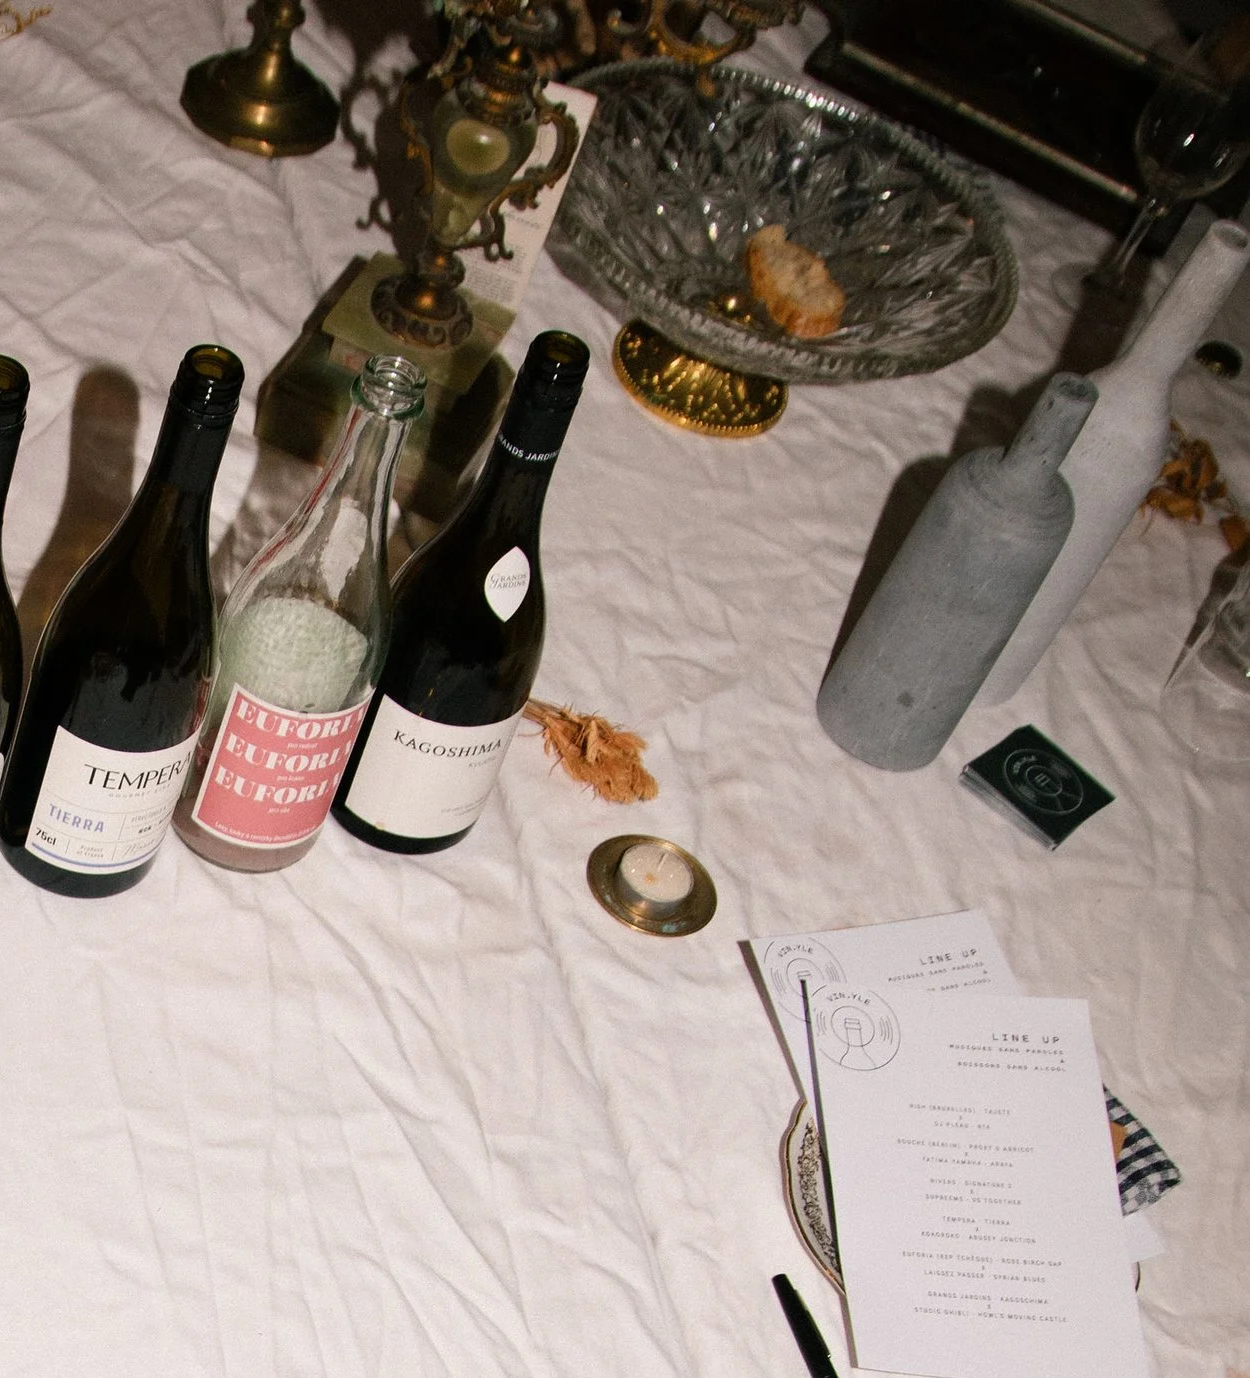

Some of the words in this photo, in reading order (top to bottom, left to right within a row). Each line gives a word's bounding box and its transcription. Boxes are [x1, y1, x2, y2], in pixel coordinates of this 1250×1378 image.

[394, 729, 502, 758] KAGOSHIMA
[50, 803, 104, 833] TIERRA
[36, 827, 57, 846] 75cl
[920, 953, 952, 965] LINE
[962, 949, 977, 958] UP
[992, 1032, 1030, 1043] LINE
[1042, 1035, 1060, 1044] UP
